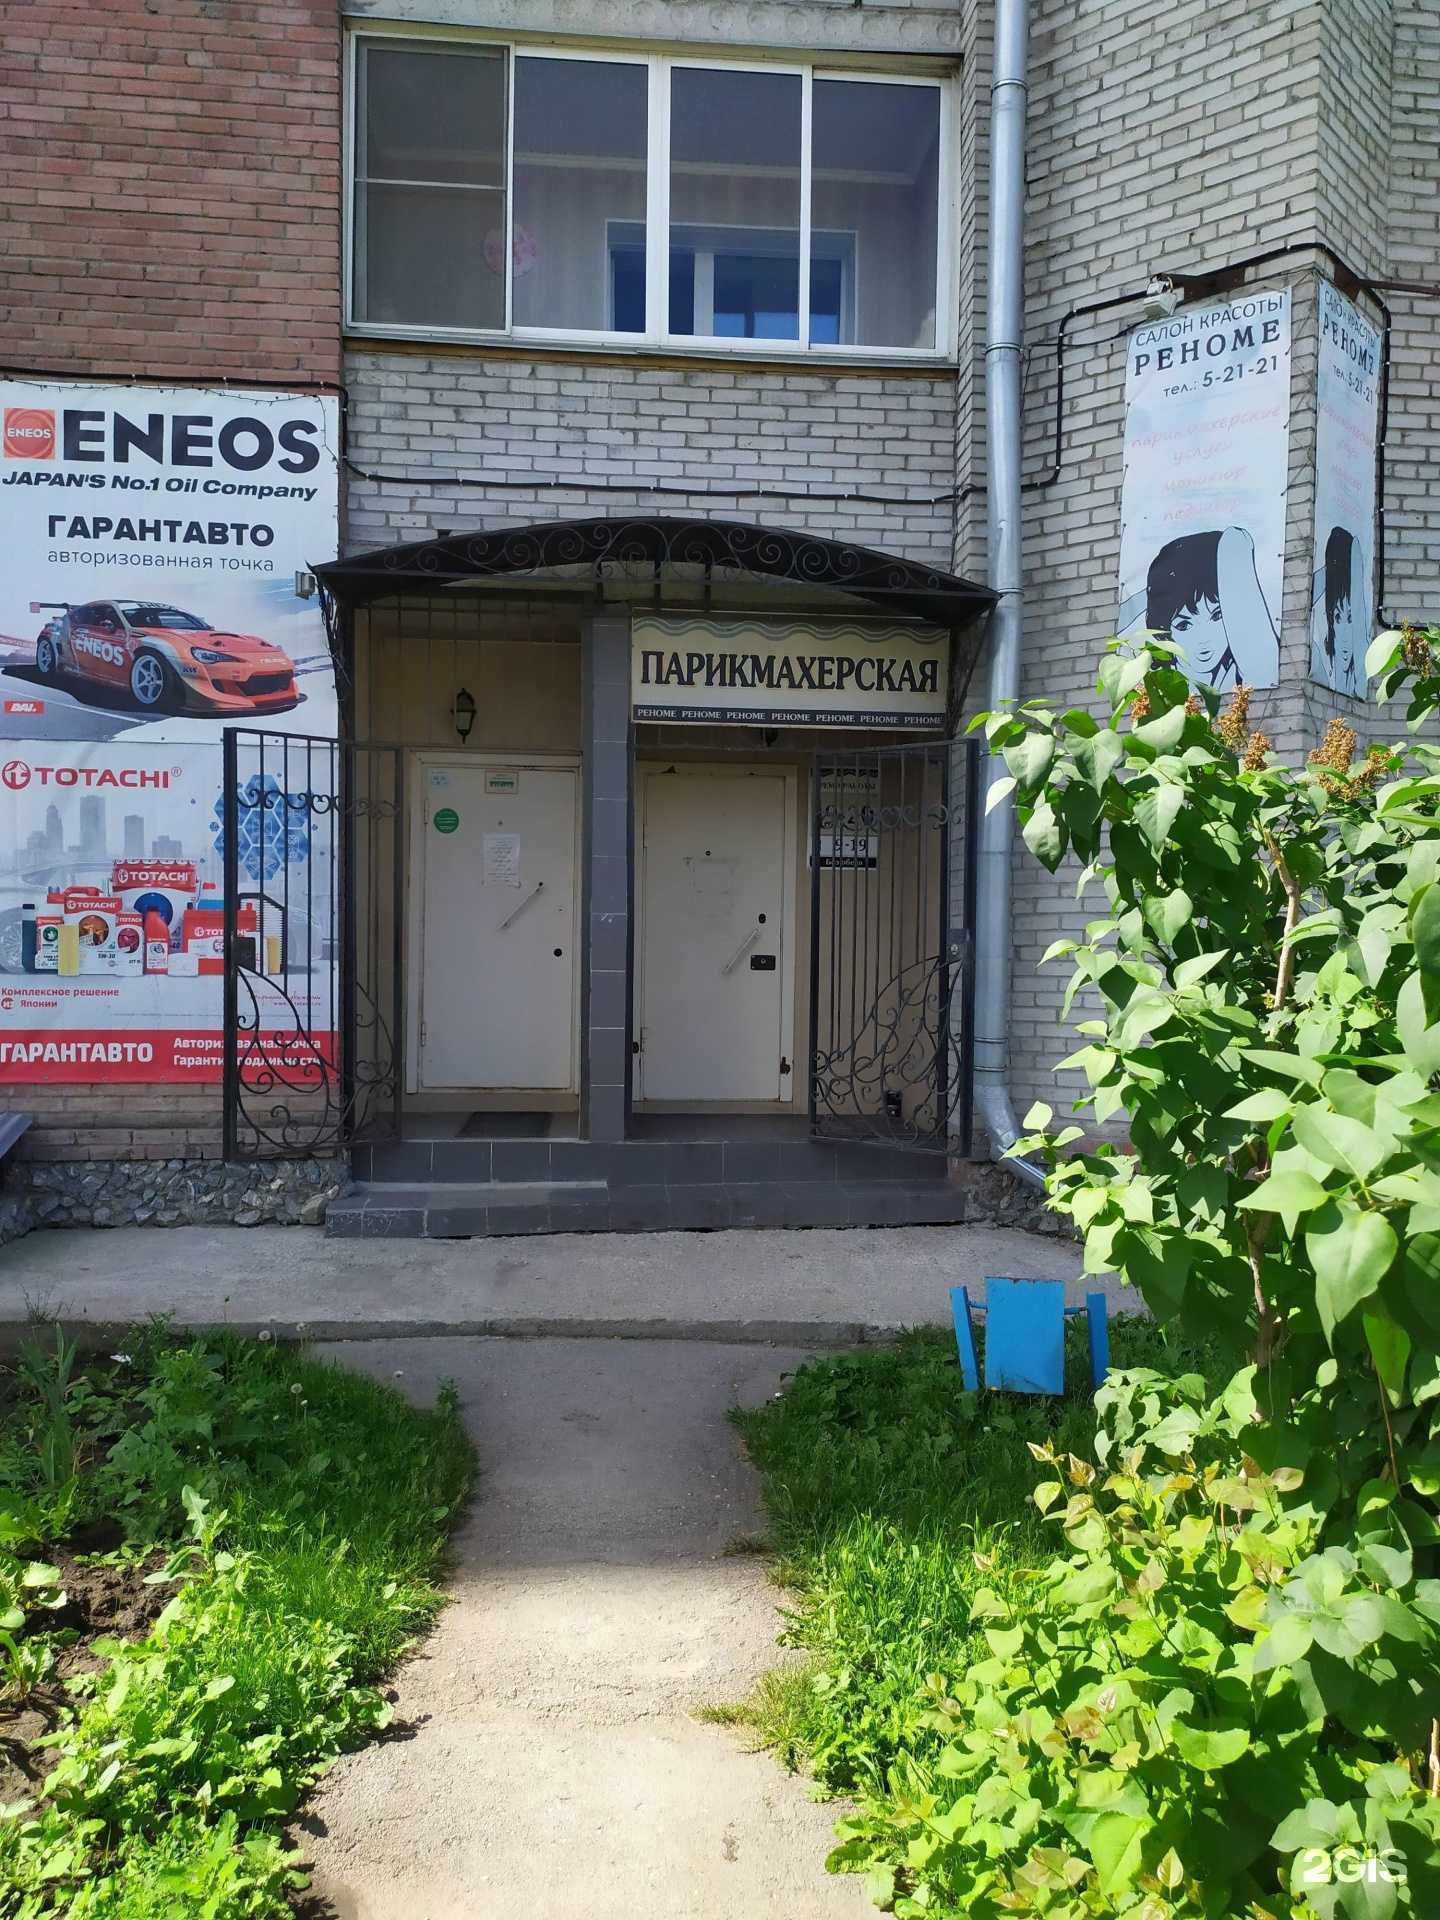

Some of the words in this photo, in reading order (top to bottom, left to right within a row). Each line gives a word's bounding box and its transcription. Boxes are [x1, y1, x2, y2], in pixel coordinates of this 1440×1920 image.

[1135, 317, 1194, 346] САЛОН
[1199, 295, 1283, 330] КРАСОТЫ
[1134, 319, 1281, 376] РЕНОМЕ
[1202, 355, 1278, 388] 5-21-21
[7, 427, 51, 439] ENEOS
[63, 409, 320, 474] ENEOS
[2, 471, 106, 489] JAPAN'S
[111, 475, 159, 491] No.1
[165, 477, 198, 493] Oil
[202, 479, 318, 502] Company
[48, 514, 274, 547] ГАРАНТАВТО
[47, 549, 213, 569] авторизованная
[221, 556, 274, 572] точка
[74, 638, 124, 666] ENEOS
[641, 650, 939, 693] ПАРИКМАХЕРСКАЯ
[637, 708, 677, 718] РЕНОМЕ
[682, 710, 721, 719] РЕНОМЕ
[726, 711, 766, 720] РЕНОМЕ
[771, 712, 811, 722] РЕНОМЕ
[815, 713, 855, 723] РЕНОМЕ
[860, 715, 899, 724] РЕНОМЕ
[904, 716, 944, 725] РЕНОМЕ
[35, 767, 169, 789] TOTACHI
[130, 872, 188, 881] TOTACHI
[1, 987, 70, 997] Комплексное
[73, 988, 119, 998] решение
[20, 1000, 58, 1008] Японии
[0, 1042, 153, 1063] ГАРАНТАВТО
